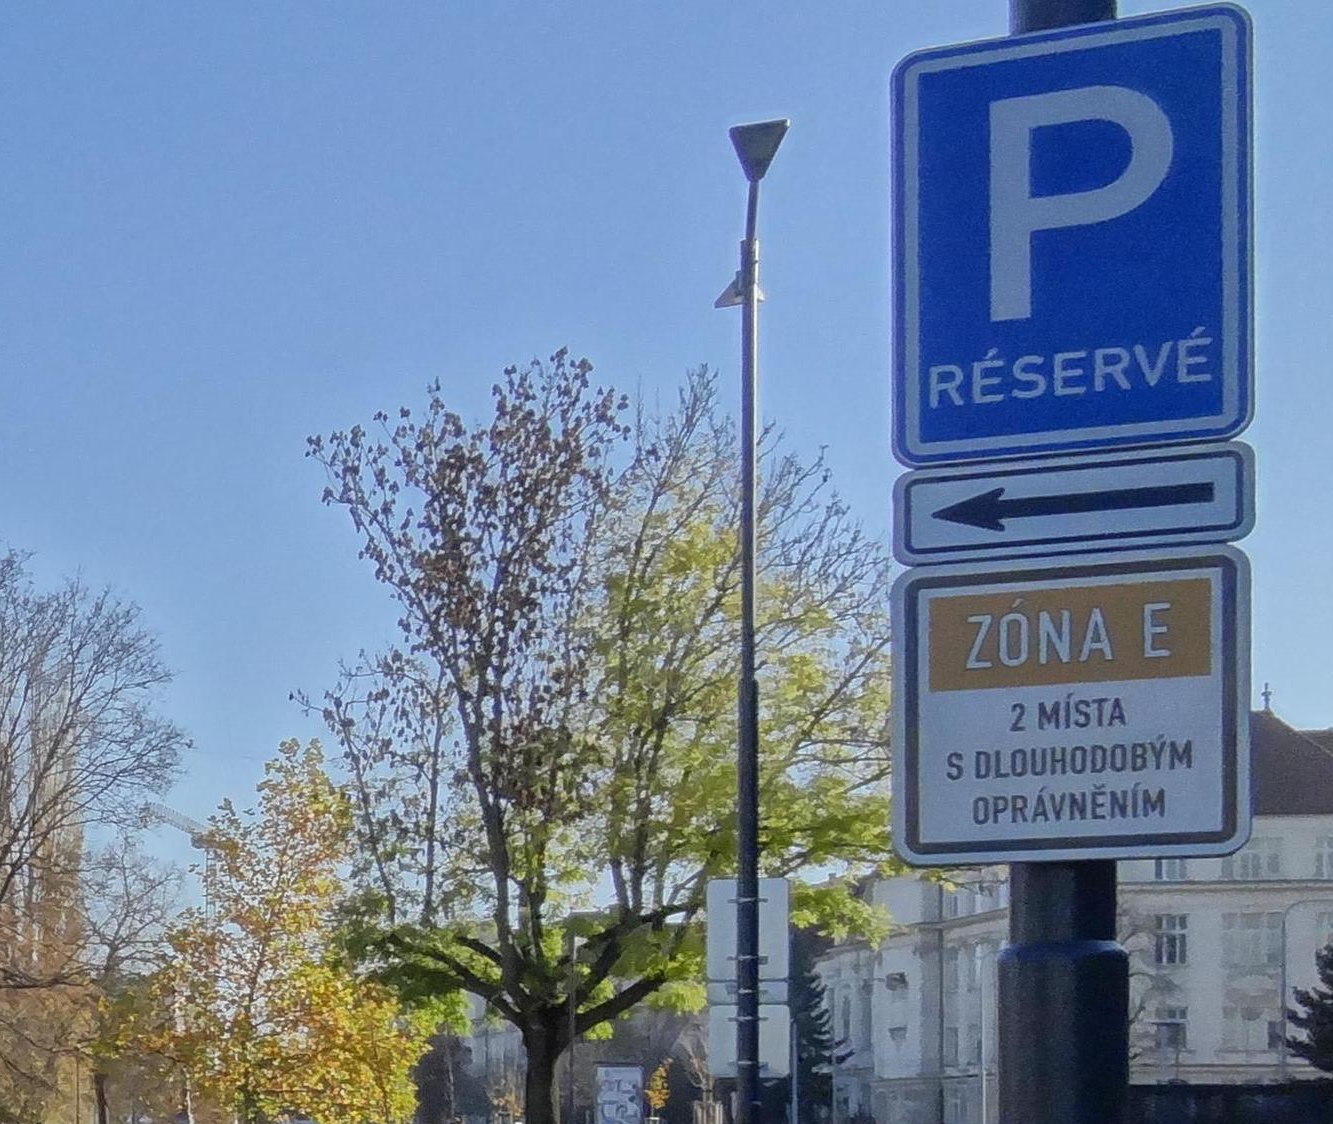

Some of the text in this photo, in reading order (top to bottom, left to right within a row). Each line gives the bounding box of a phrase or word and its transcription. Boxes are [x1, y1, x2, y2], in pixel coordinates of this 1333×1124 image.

[989, 84, 1174, 323] P
[928, 326, 1213, 409] RÉSERVÉ
[965, 598, 1172, 670] ZÓNA E
[1010, 692, 1127, 732] 2 MÍSTA
[946, 733, 1193, 781] S DLOUHODOBÝM
[972, 783, 1166, 826] OPRÁVNĚNÍM
